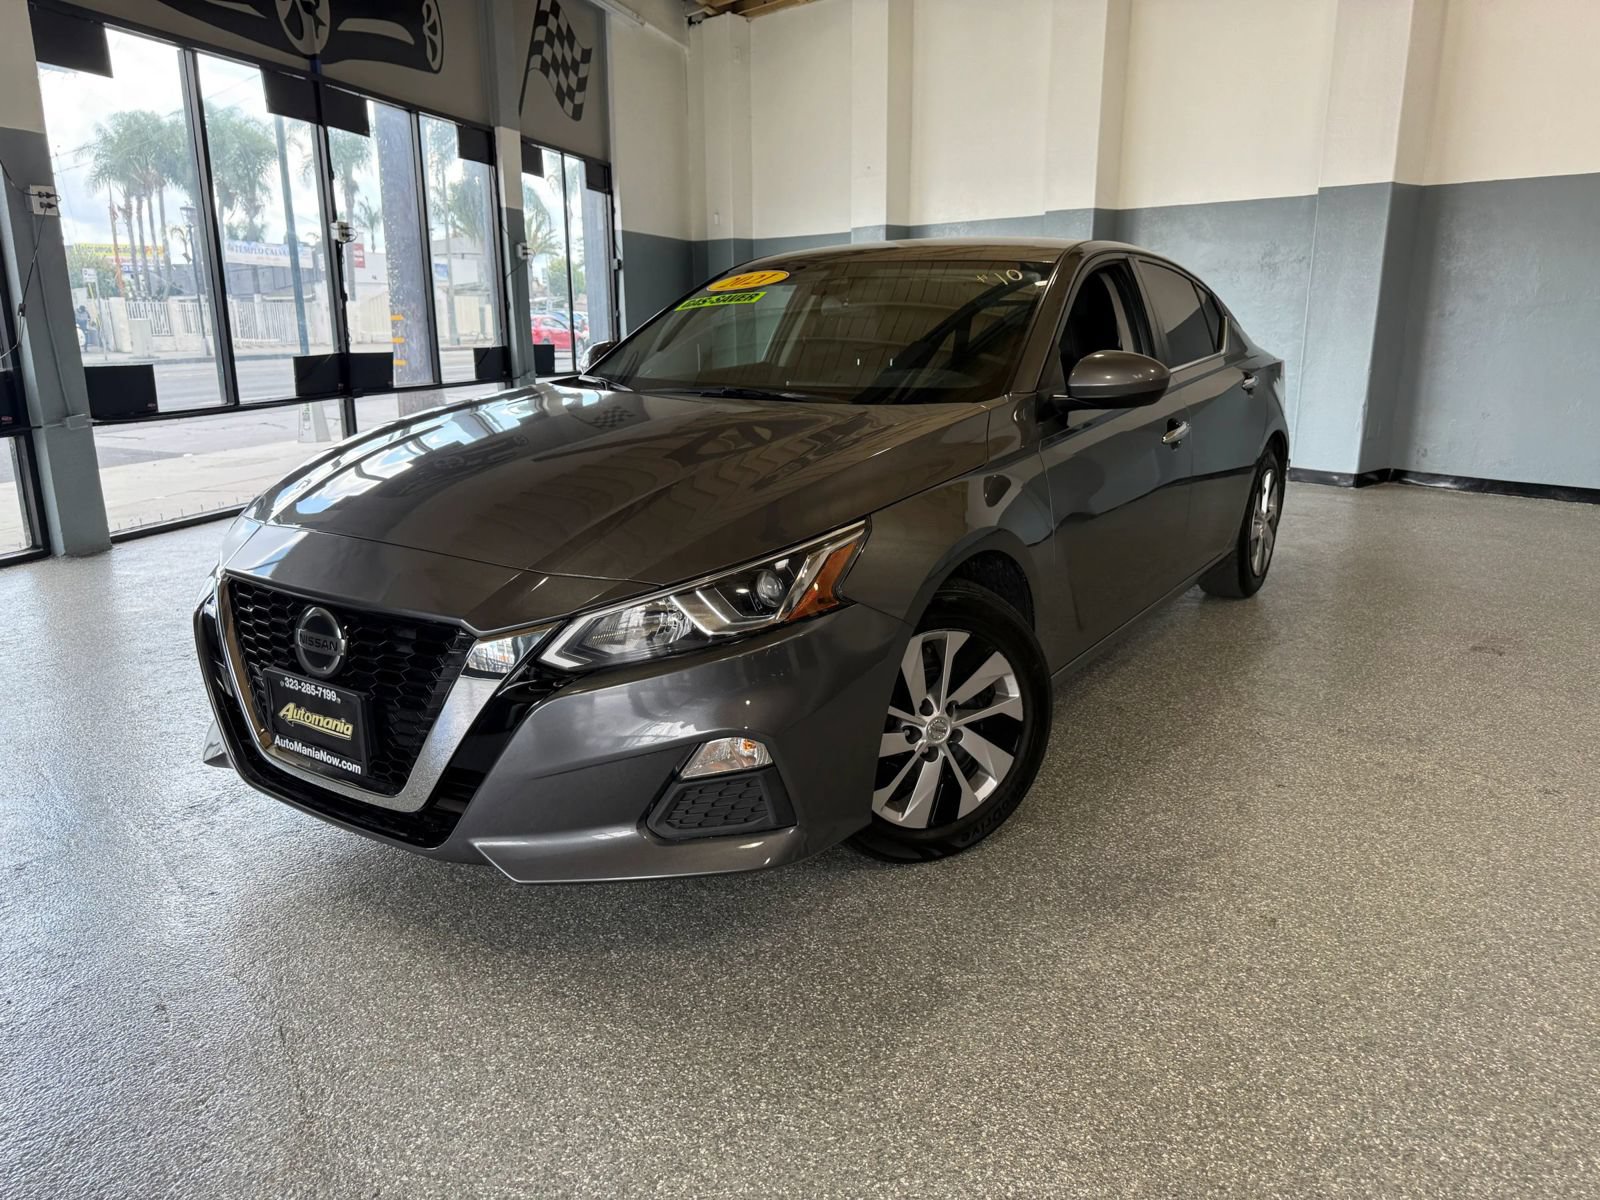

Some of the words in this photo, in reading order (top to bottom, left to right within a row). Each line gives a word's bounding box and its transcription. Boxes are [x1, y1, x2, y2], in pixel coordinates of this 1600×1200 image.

[717, 272, 778, 289] 2021
[299, 633, 338, 650] NISSAN
[284, 677, 337, 701] 323-285-7199
[278, 702, 354, 738] Automania
[274, 734, 362, 775] AutoManiaNow.com
